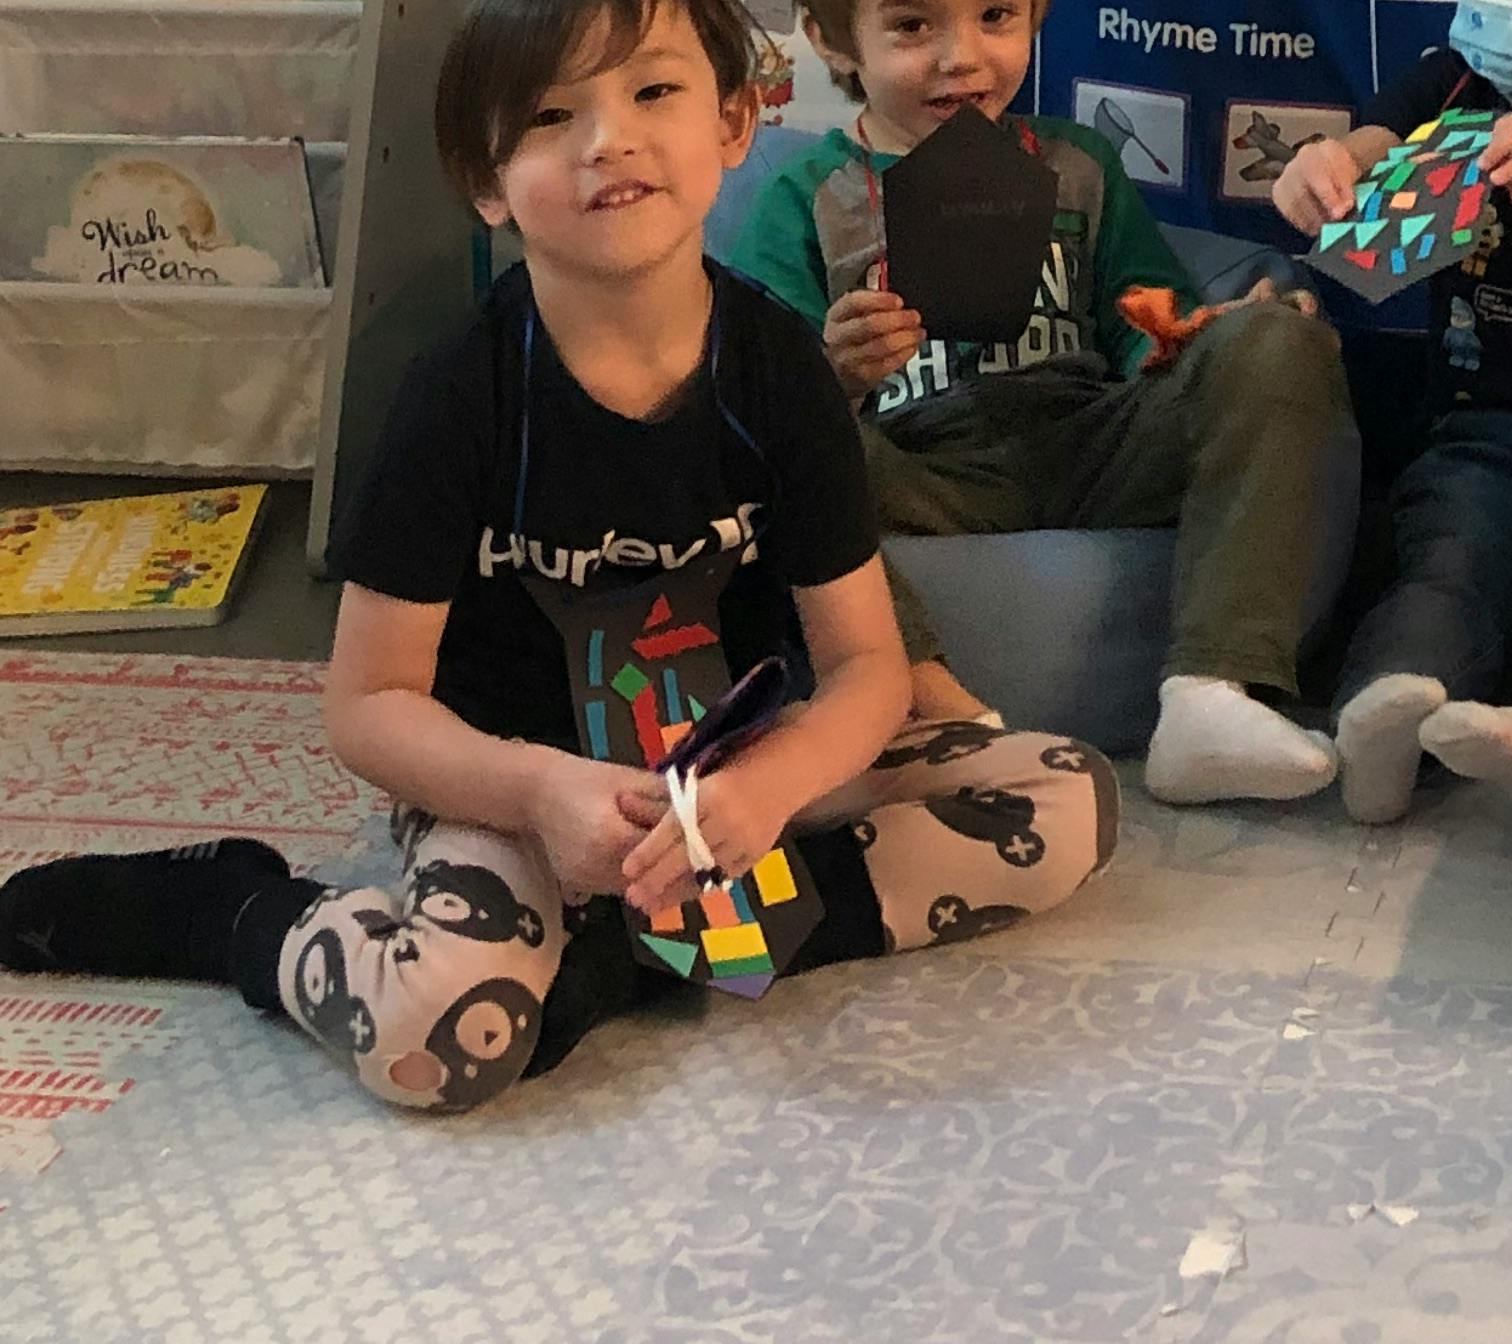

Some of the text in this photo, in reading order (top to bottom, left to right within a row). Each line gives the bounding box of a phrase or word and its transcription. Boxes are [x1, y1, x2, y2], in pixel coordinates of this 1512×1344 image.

[1098, 6, 1316, 59] Rhyme Time
[80, 208, 172, 252] Wish
[97, 252, 219, 284] dream
